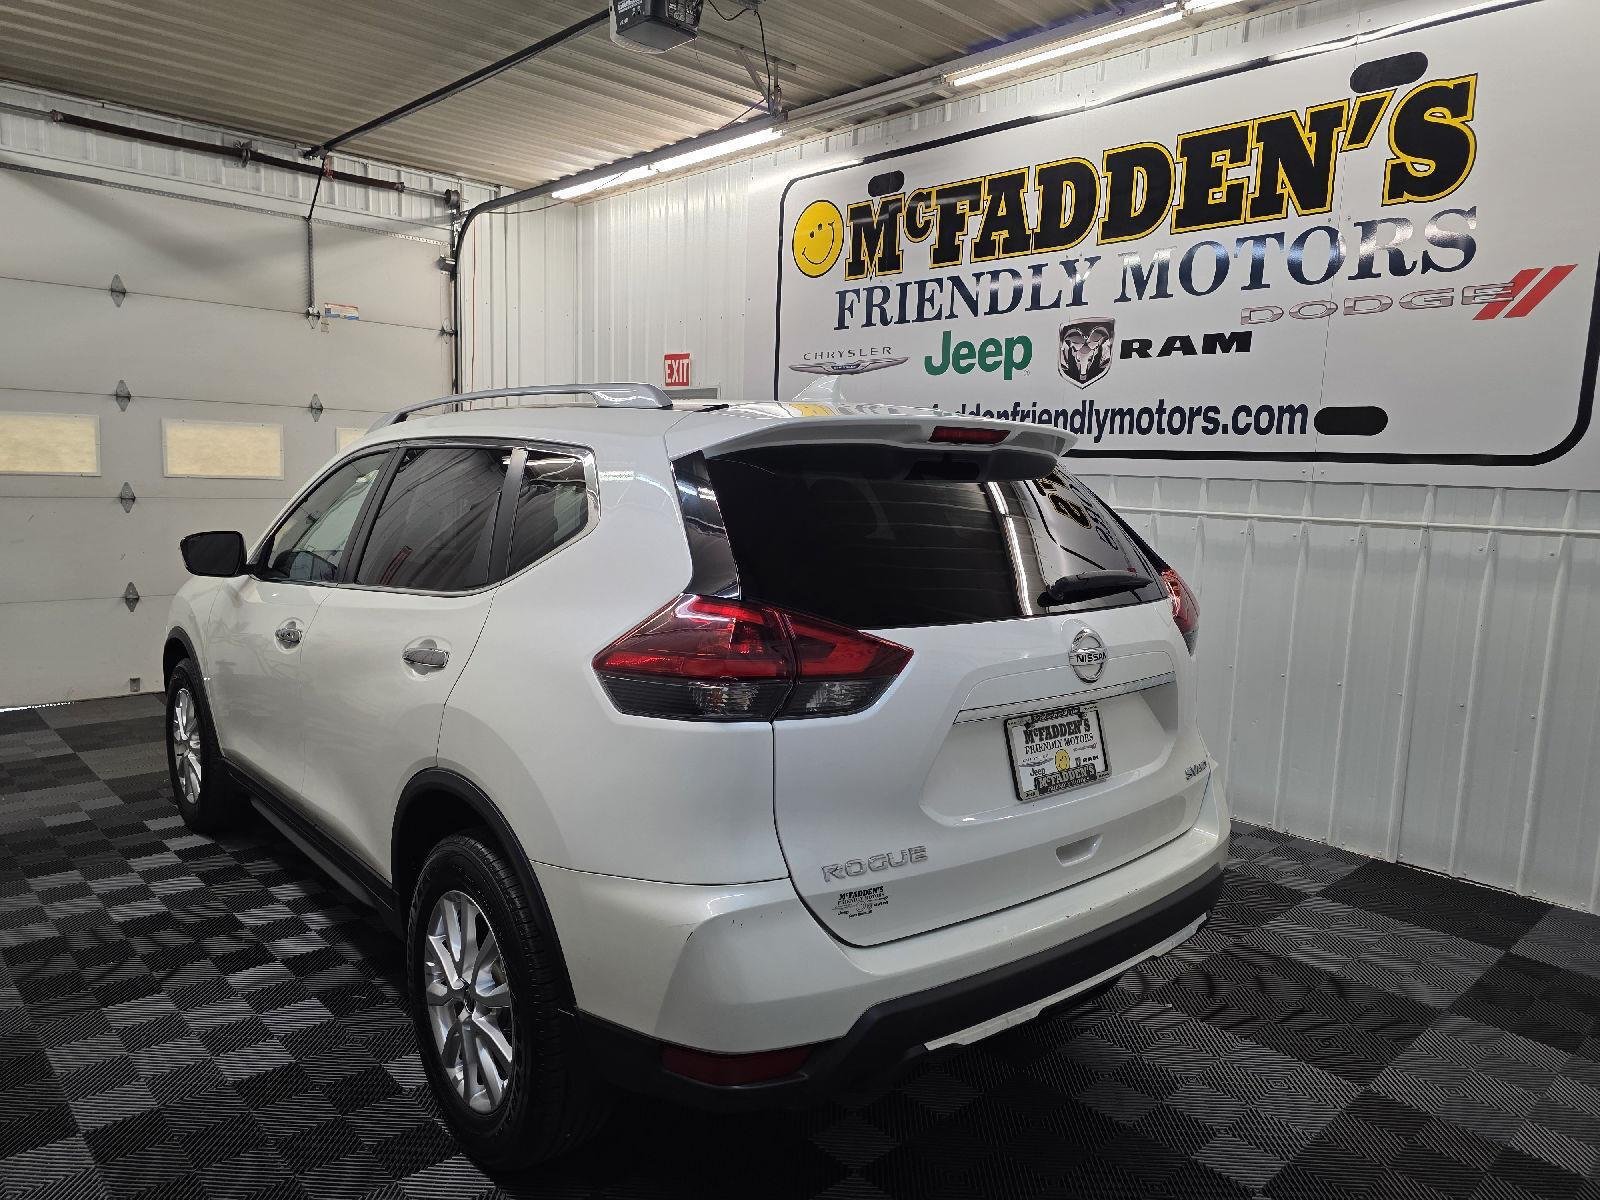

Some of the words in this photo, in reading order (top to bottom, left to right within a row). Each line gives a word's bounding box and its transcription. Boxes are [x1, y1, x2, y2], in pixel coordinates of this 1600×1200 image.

[834, 255, 1101, 330] FRIENDLY
[1114, 207, 1478, 303] MOTORS
[1241, 281, 1515, 325] DODGE
[803, 346, 892, 361] CHRYSLER
[924, 330, 1033, 380] Jeep
[1120, 331, 1252, 359] RAM
[665, 359, 689, 383] EXIT
[1076, 652, 1107, 662] NISSAN
[1024, 739, 1062, 755] FRIENDLY
[1064, 733, 1094, 747] MOTORS
[821, 845, 928, 882] ROGUE
